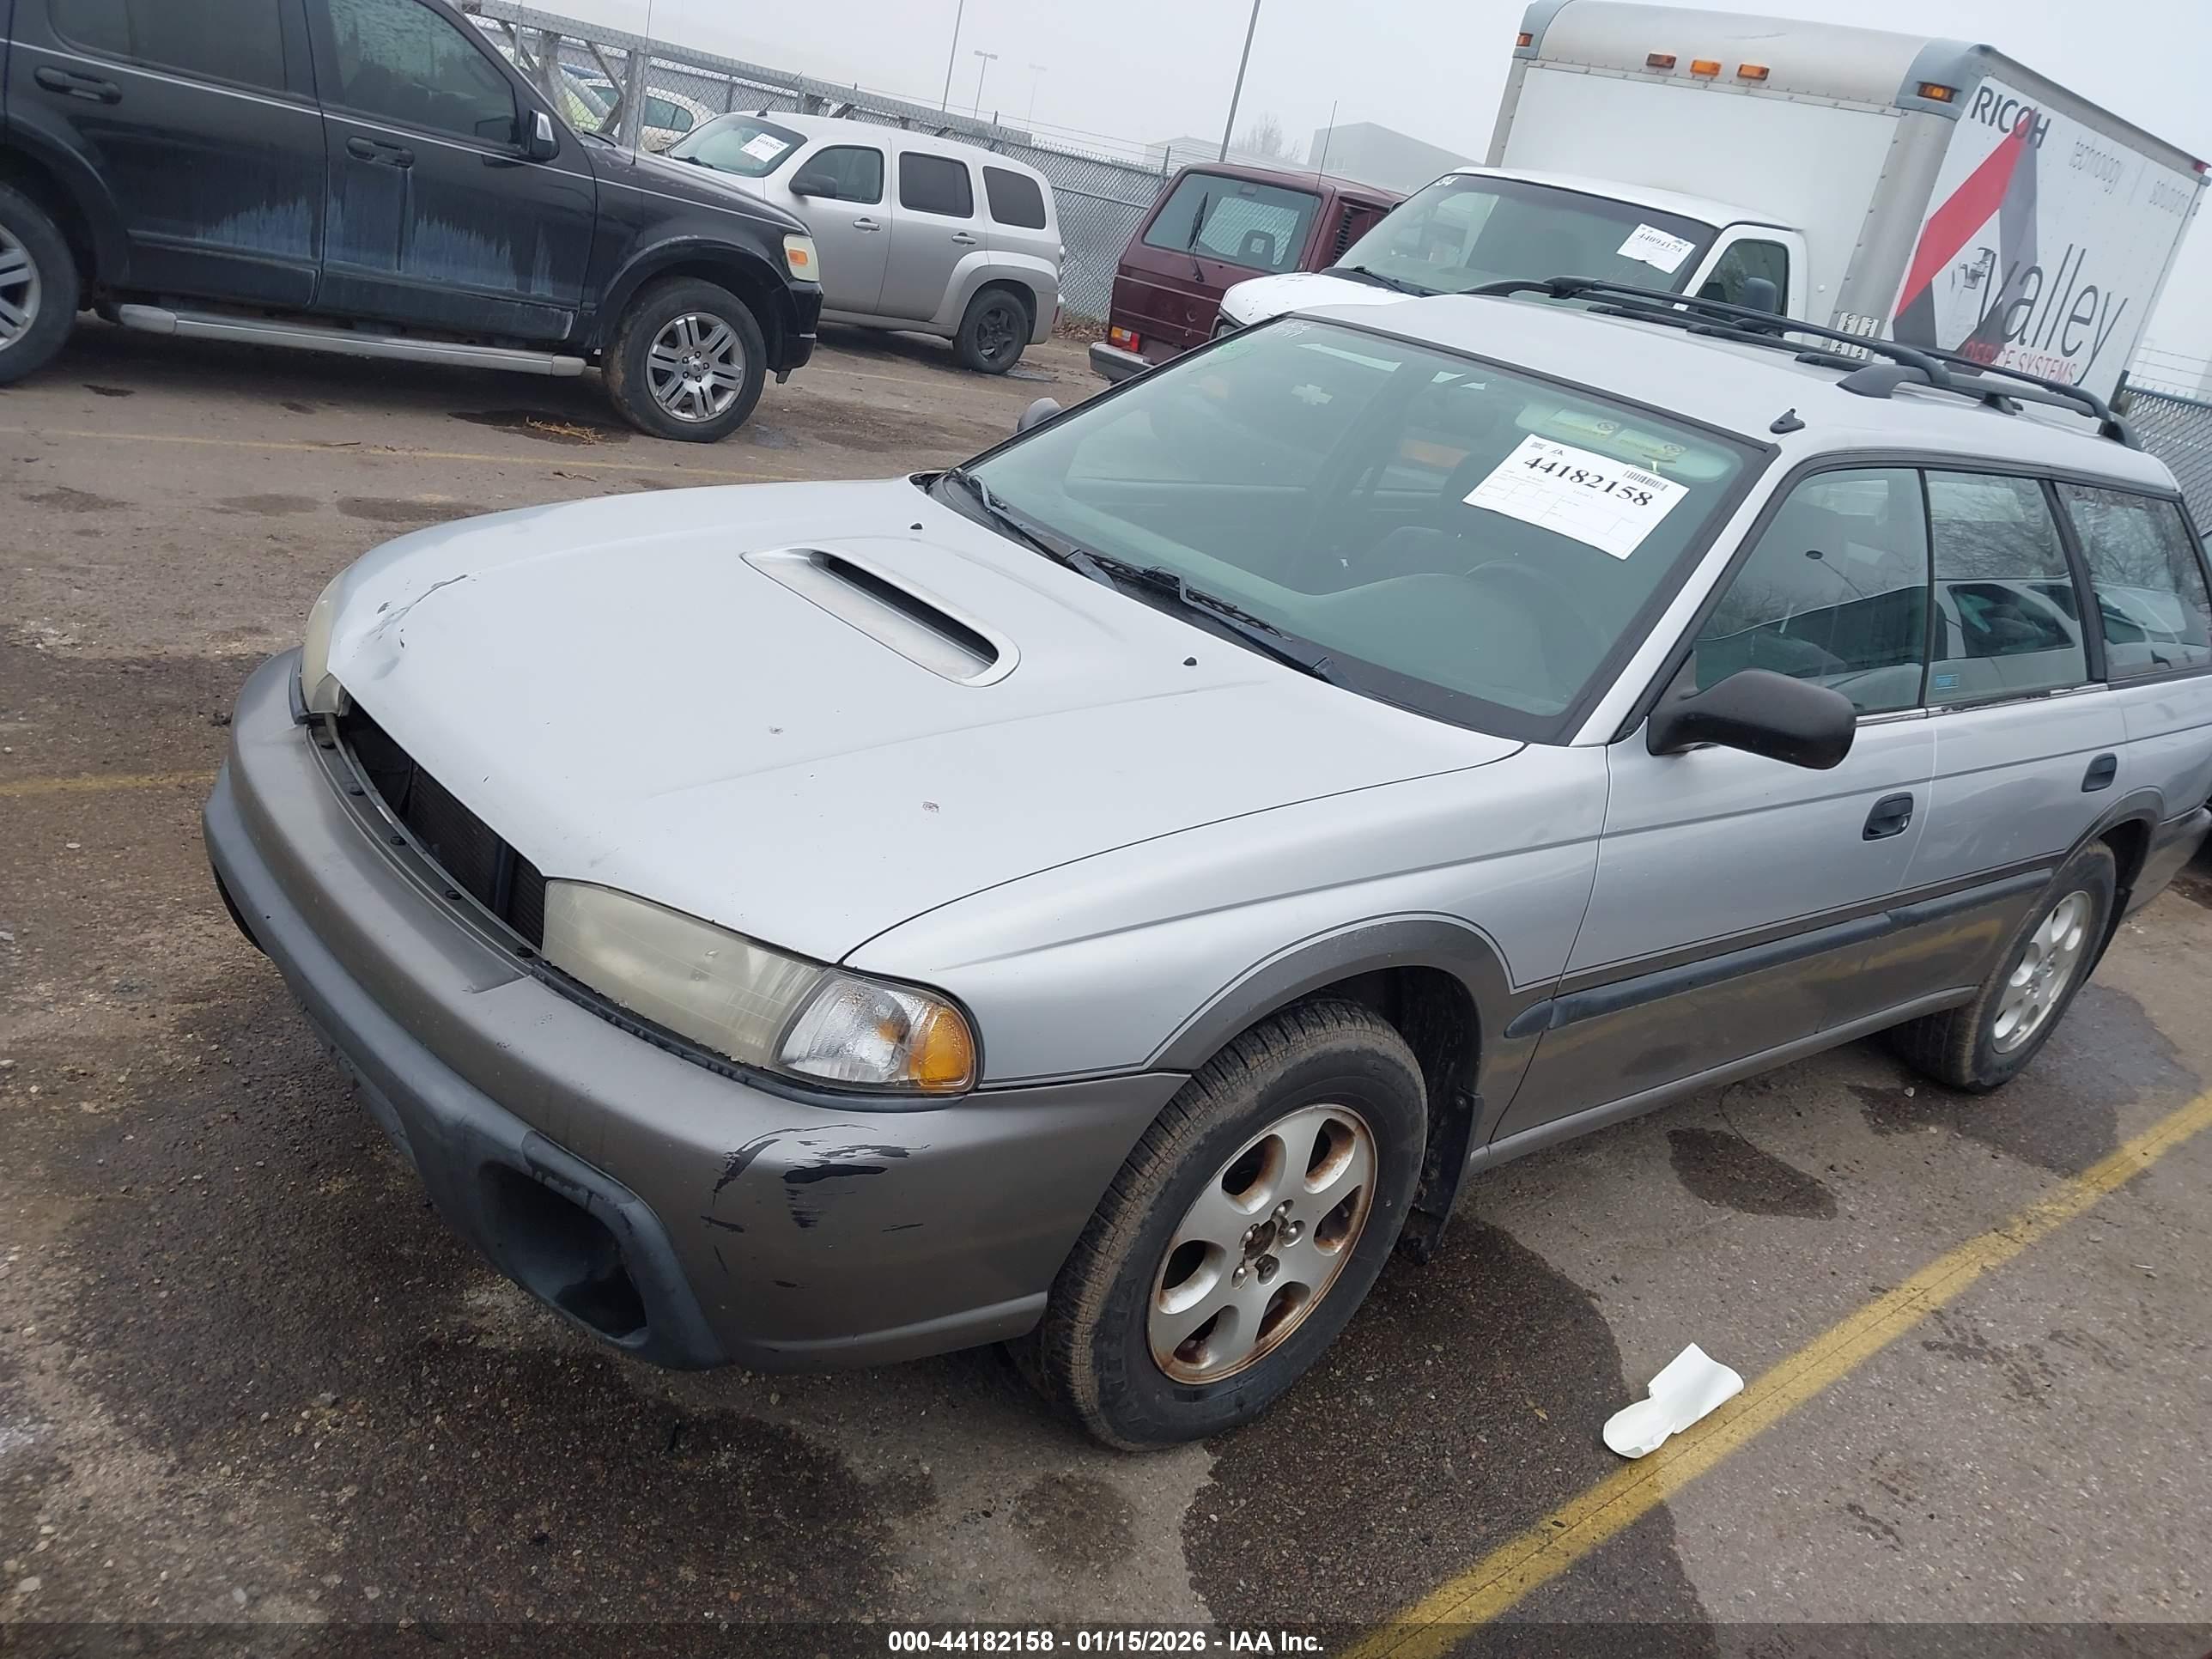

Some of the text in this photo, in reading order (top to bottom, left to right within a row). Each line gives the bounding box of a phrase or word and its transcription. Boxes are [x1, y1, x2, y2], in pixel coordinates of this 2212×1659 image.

[1970, 86, 2051, 149] RICOH
[1975, 243, 2129, 387] valley
[2017, 351, 2077, 386] SYSTEMS
[1523, 457, 1654, 507] 44182158
